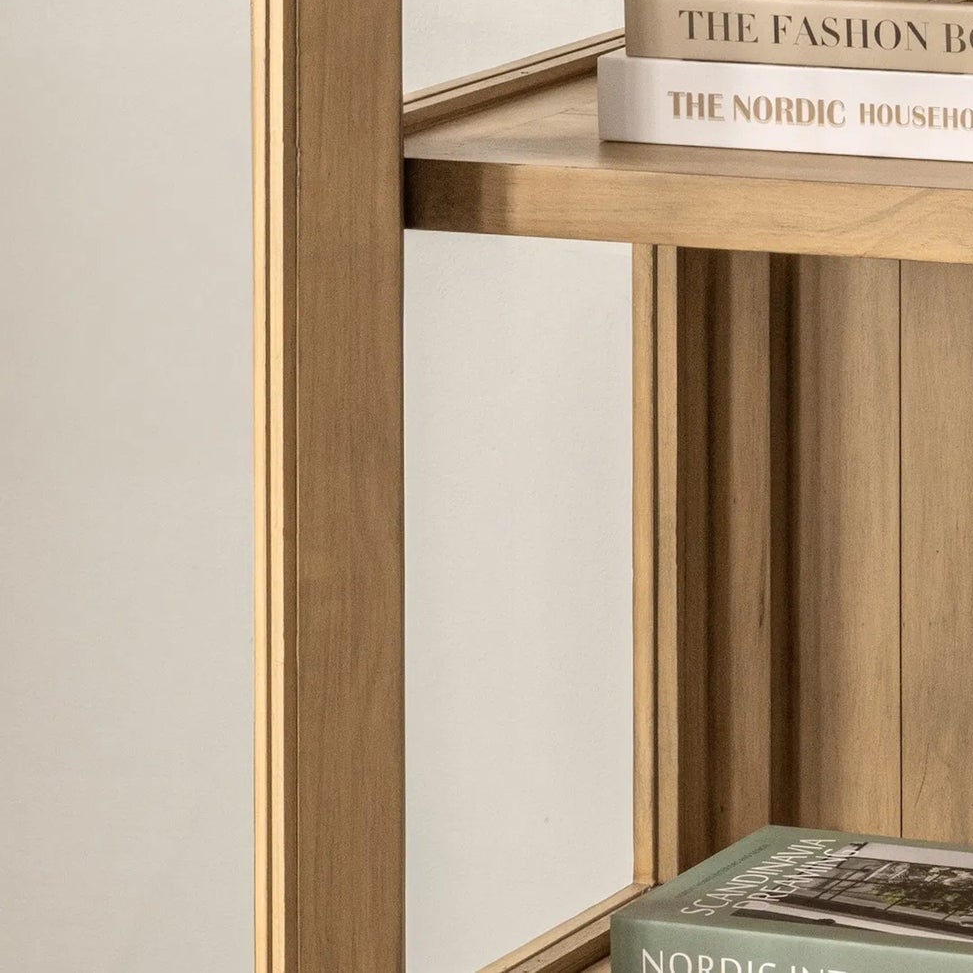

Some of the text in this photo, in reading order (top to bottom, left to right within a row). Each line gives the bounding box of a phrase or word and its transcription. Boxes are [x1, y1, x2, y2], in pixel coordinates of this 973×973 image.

[678, 9, 759, 43] THE
[770, 13, 930, 51] FASHON
[667, 90, 726, 122] THE
[732, 93, 847, 129] NORDIC
[680, 838, 837, 917] SCANDINAVIA
[731, 847, 861, 911] DREAMING
